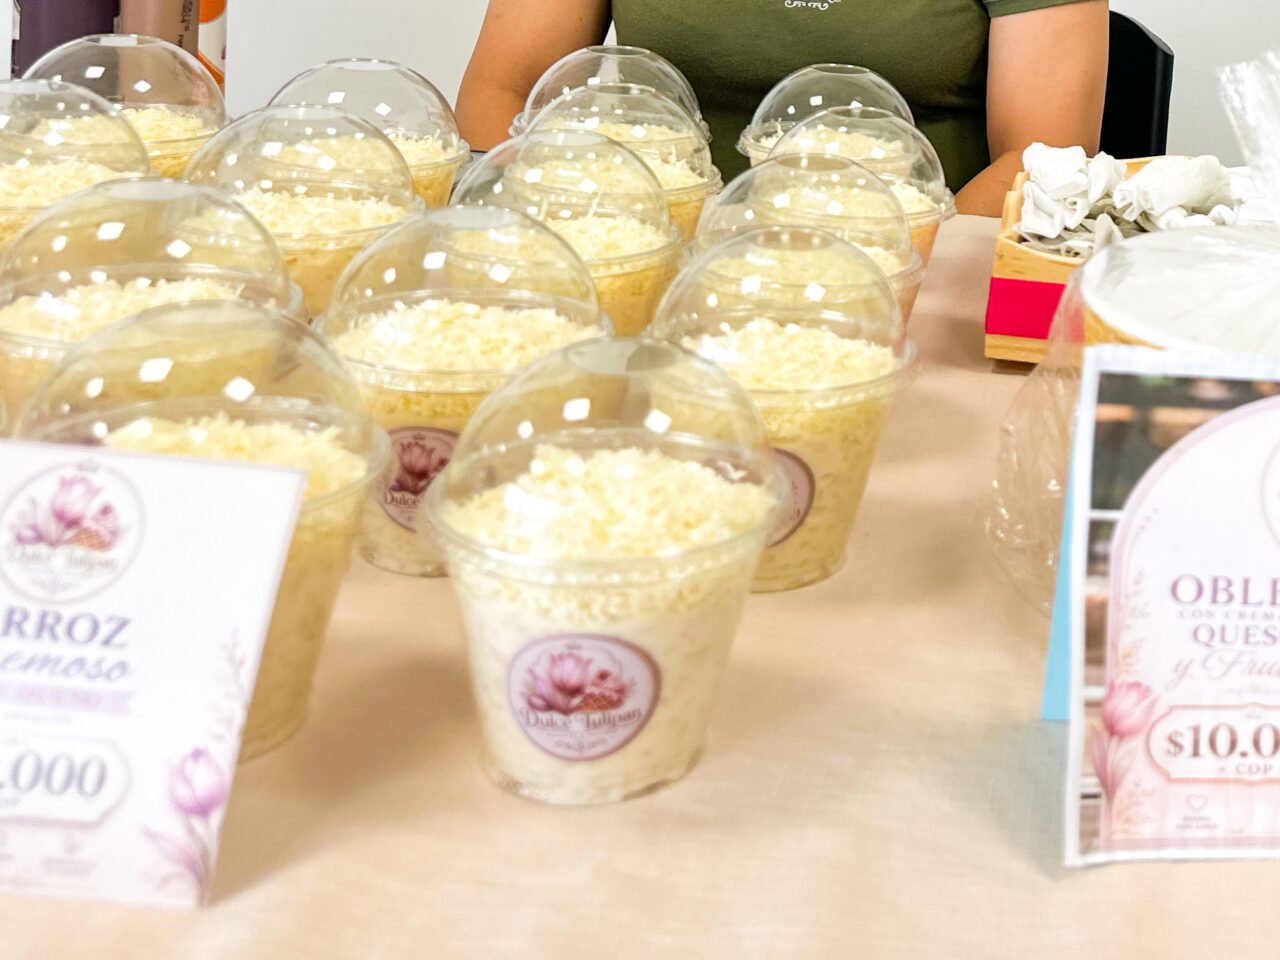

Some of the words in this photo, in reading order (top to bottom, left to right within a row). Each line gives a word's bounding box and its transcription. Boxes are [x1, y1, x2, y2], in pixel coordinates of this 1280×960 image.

[1178, 608, 1216, 620] CON
[519, 707, 573, 729] Dulce
[1235, 762, 1273, 775] COP
